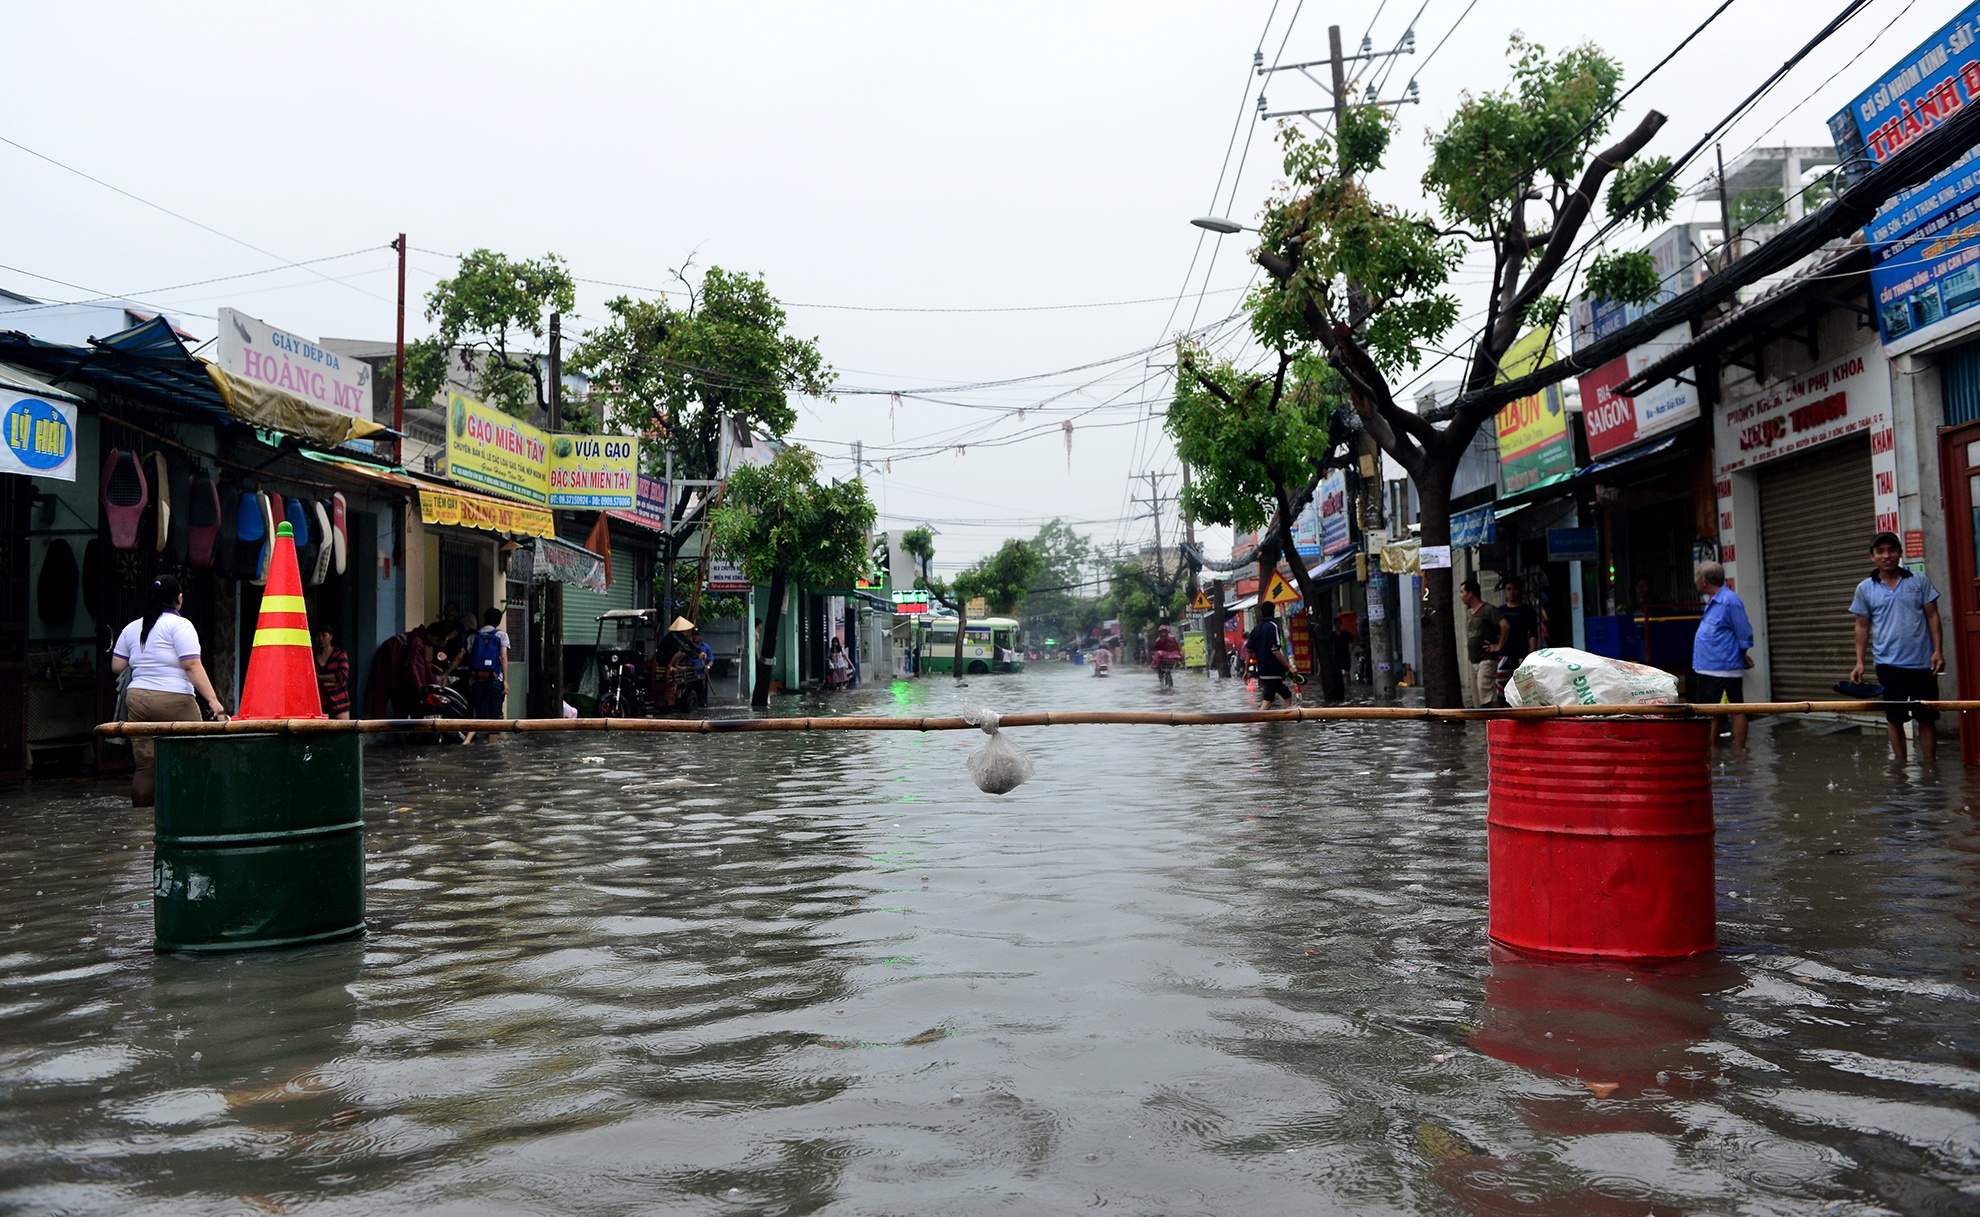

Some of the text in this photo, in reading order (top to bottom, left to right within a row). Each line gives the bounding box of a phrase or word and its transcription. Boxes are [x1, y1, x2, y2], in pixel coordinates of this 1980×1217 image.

[1888, 68, 1921, 101] NHÔM
[1917, 42, 1949, 79] KÍNH
[1866, 75, 1964, 163] THÀNH
[272, 331, 340, 370] GIÀY DÉP DA
[243, 347, 364, 414] HOÀNG MY
[1808, 371, 1830, 393] PHỤ
[1833, 356, 1865, 382] KHOA
[1596, 384, 1612, 404] BIA
[1788, 391, 1848, 433] TRINH
[34, 410, 68, 458] HẢI
[1587, 397, 1630, 437] SAIGON
[467, 412, 547, 464] GẠO MIỀN TÂY
[575, 438, 630, 461] VỰA GẠO
[1872, 424, 1894, 456] KHÁM
[550, 464, 632, 492] ĐẶC SẢN MIỀN TÂY
[1876, 470, 1894, 496] THAI
[498, 508, 513, 526] MY
[1422, 588, 1430, 600] 2
